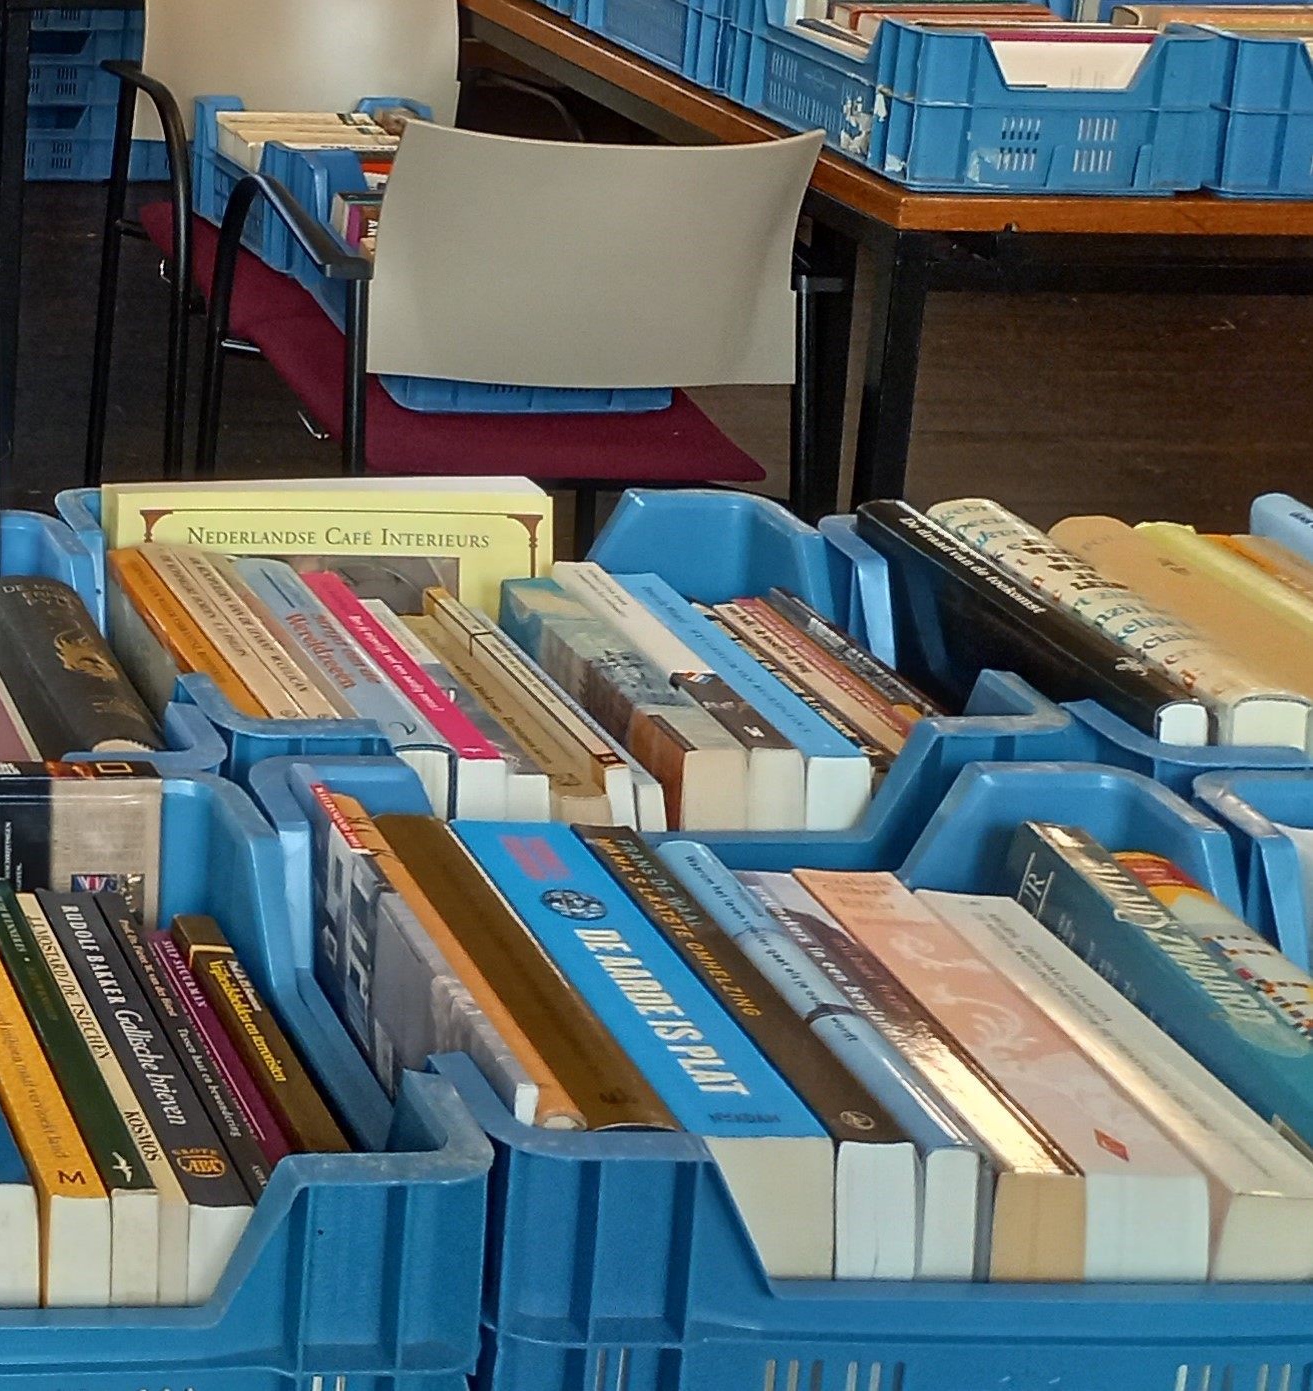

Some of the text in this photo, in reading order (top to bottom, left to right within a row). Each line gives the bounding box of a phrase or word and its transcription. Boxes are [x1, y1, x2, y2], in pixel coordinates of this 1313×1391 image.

[187, 527, 490, 548] NEDERLANDSE CAFÉ INTERIEURS
[910, 527, 961, 552] draad
[944, 551, 982, 566] van
[981, 575, 1053, 613] toekomst
[612, 838, 663, 875] FRANS
[659, 895, 706, 927] WAAL
[678, 855, 720, 885] Waarom
[705, 885, 732, 898] het
[591, 836, 763, 1016] MAMA'S LAATSTE OMHELZING
[717, 898, 752, 919] leven
[743, 884, 817, 943] pretmakers
[815, 961, 854, 981] een
[58, 904, 129, 1004] RUDOLF BAKKER
[763, 948, 795, 967] gaat
[780, 967, 807, 979] als
[1141, 929, 1282, 1025] ZWAARD
[171, 959, 208, 1007] STUURMAN
[69, 1003, 113, 1059] TSJECHEN
[592, 955, 686, 1015] AARDE
[664, 1045, 751, 1095] PLAT
[824, 1017, 864, 1042] wordt
[110, 1009, 197, 1125] Gallische brieven
[175, 1027, 201, 1053] Tussen
[189, 1055, 211, 1073] haat
[204, 1084, 243, 1137] bewondering
[248, 1036, 291, 1081] terroristen
[123, 1110, 163, 1162] KOSMOS
